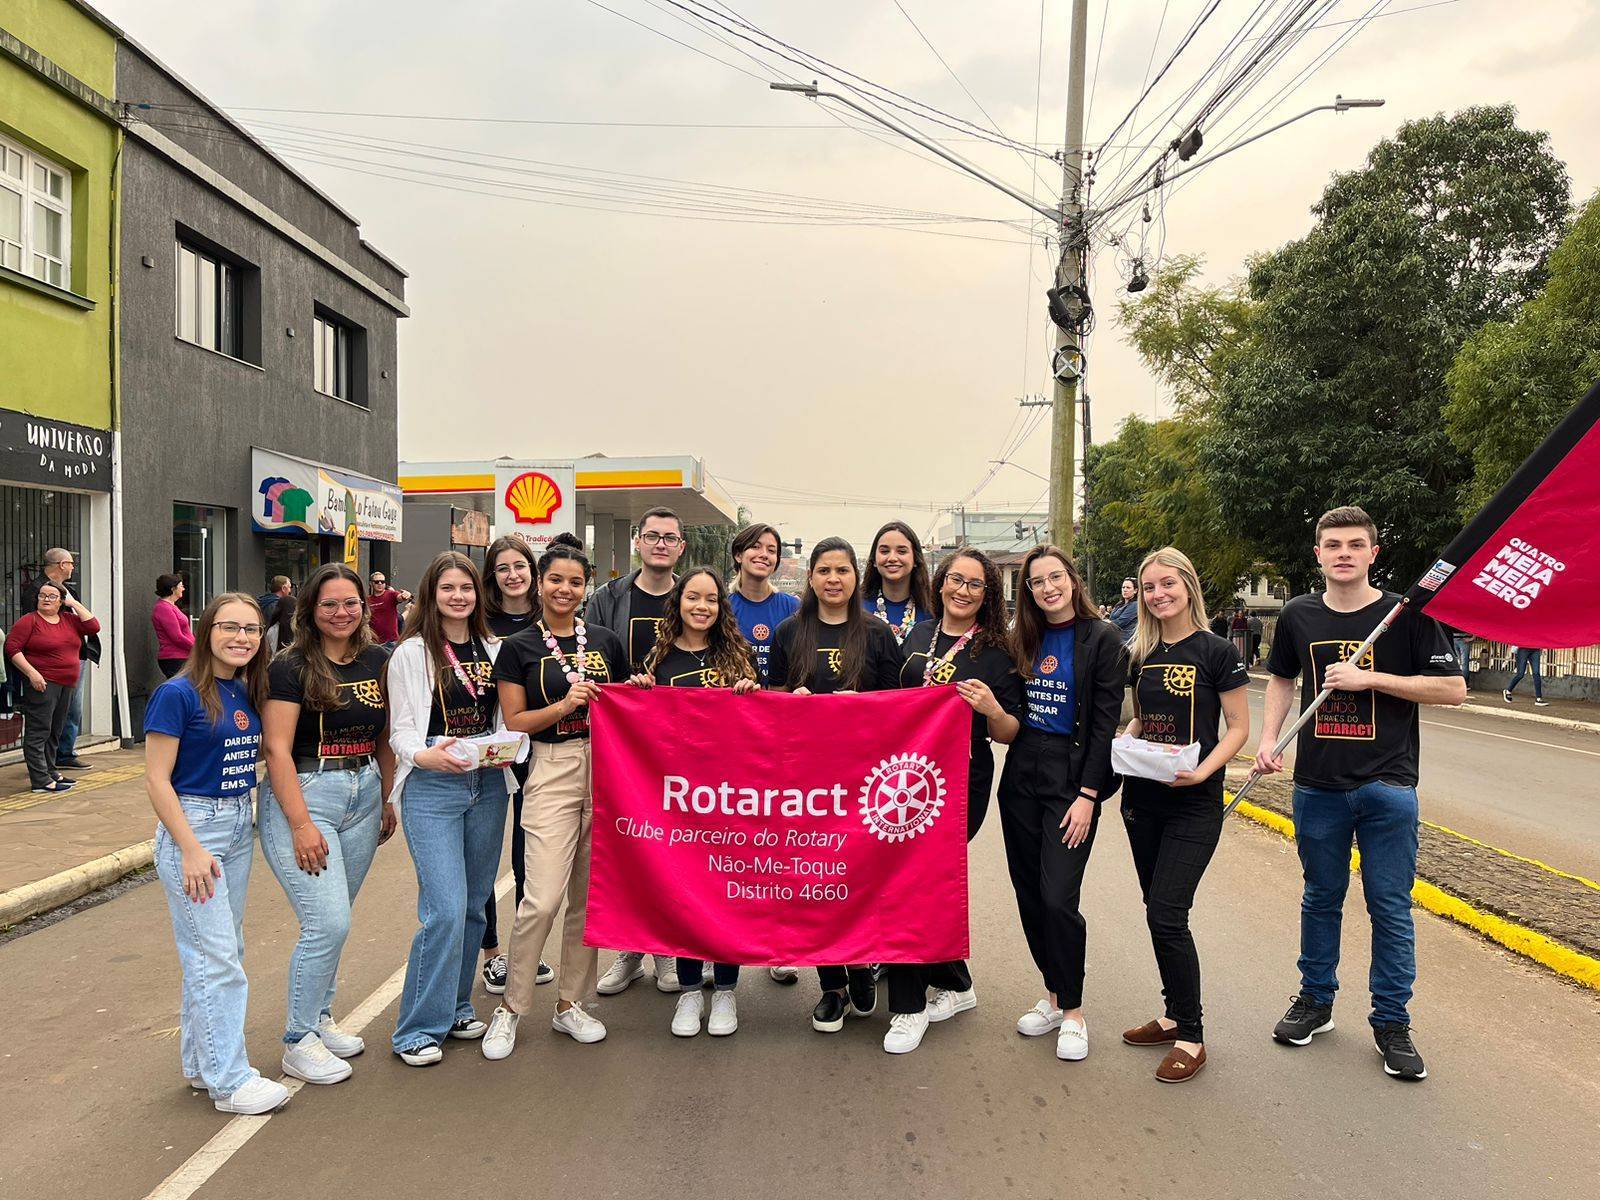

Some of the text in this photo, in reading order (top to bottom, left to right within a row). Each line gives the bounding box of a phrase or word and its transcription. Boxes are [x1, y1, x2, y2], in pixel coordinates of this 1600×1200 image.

[27, 422, 103, 457] UNIVERSO
[40, 453, 97, 478] DA MODA
[1495, 544, 1554, 587] MEIA
[1509, 537, 1566, 572] QUATRO
[1471, 571, 1532, 609] ZERO
[1483, 557, 1541, 600] MEIA
[1042, 679, 1055, 689] DE
[1056, 681, 1068, 691] SI,
[1053, 693, 1067, 703] DE
[224, 737, 241, 748] DAR
[241, 735, 253, 745] DE
[1317, 722, 1373, 737] ROTARACT
[222, 750, 250, 762] ANTES
[885, 761, 921, 775] ROTARY
[222, 763, 255, 776] PENSAR
[220, 780, 238, 790] EM
[662, 775, 849, 818] Rotaract
[871, 806, 933, 834] INTERNATIONAL
[615, 816, 848, 852] Clube parceiro do Rotary
[708, 854, 848, 879] Não-Me-Toque
[726, 880, 849, 902] Distrito 4660
